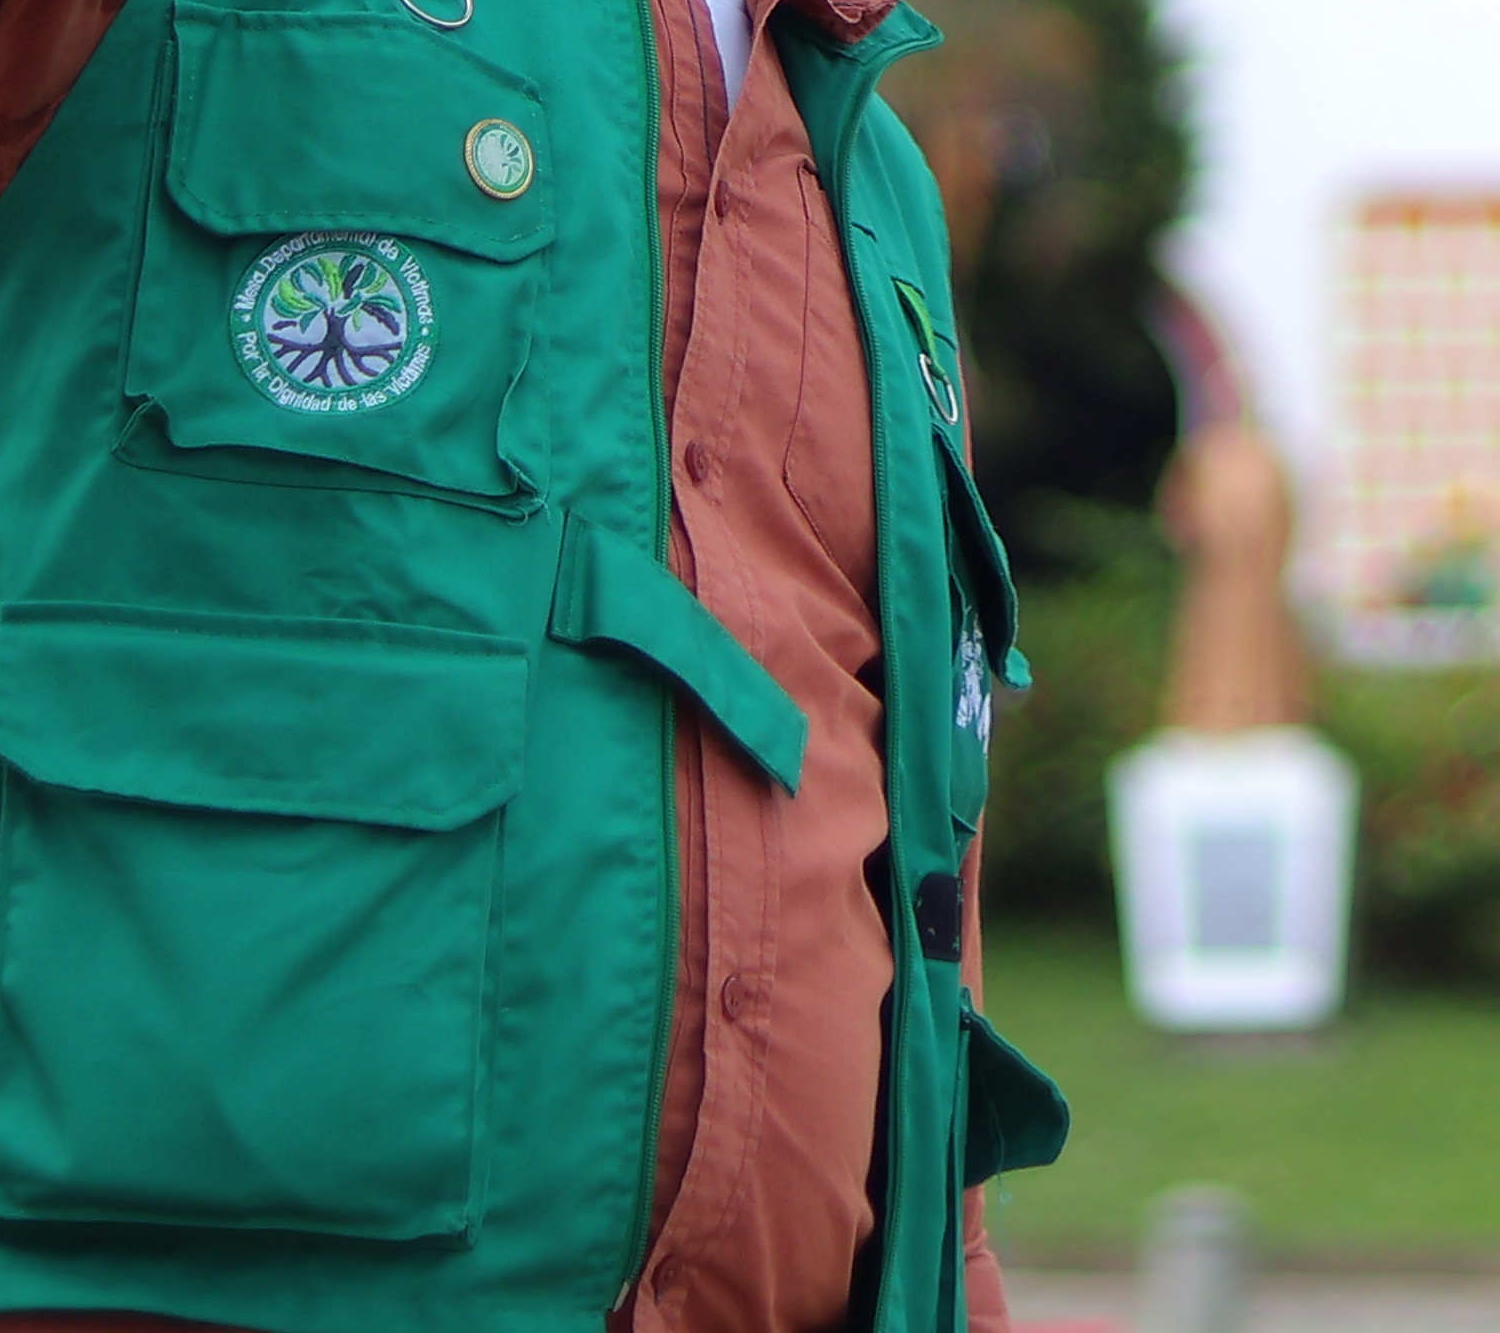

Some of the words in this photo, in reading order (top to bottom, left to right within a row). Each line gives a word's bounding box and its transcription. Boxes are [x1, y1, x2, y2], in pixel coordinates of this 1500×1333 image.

[233, 271, 264, 310] Mesa
[377, 239, 400, 261] de
[237, 331, 262, 361] Por
[268, 375, 332, 412] Dignidad
[337, 393, 358, 412] de
[359, 389, 388, 408] las
